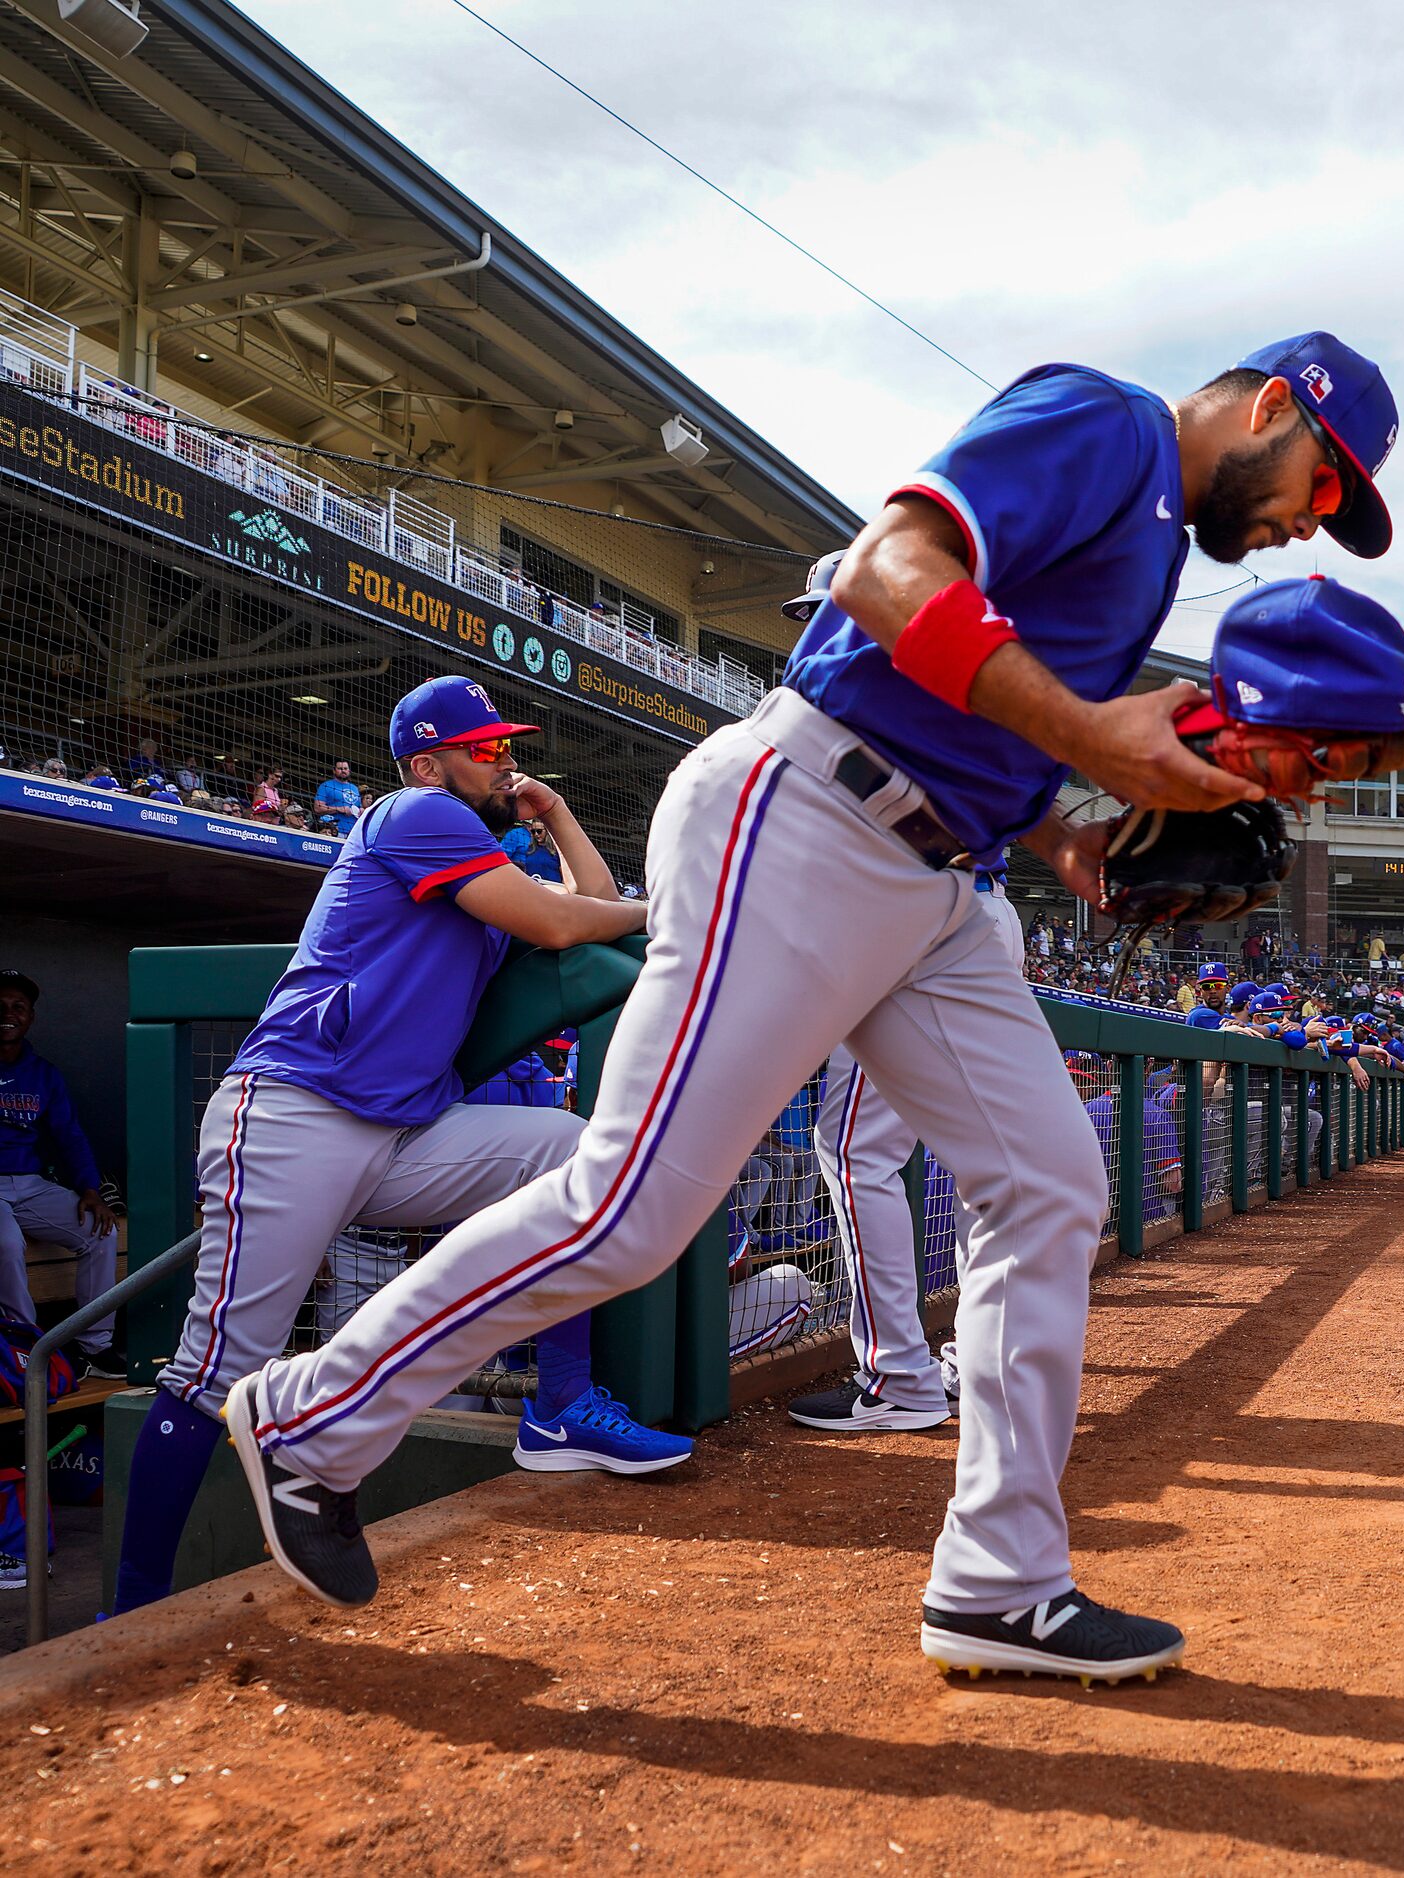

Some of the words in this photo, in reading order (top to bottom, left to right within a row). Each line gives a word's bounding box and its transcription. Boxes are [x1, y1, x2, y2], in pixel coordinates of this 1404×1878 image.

[347, 560, 452, 632] FOLLOW
[456, 607, 487, 647] US
[578, 662, 708, 736] @SurpriseStadium
[22, 785, 114, 812] texasrangers.com
[140, 809, 179, 825] @RANGERS
[206, 822, 278, 845] texasrangers.com
[301, 841, 332, 855] @RANGERS
[0, 1092, 40, 1112] GERS
[50, 1450, 100, 1475] EXAS
